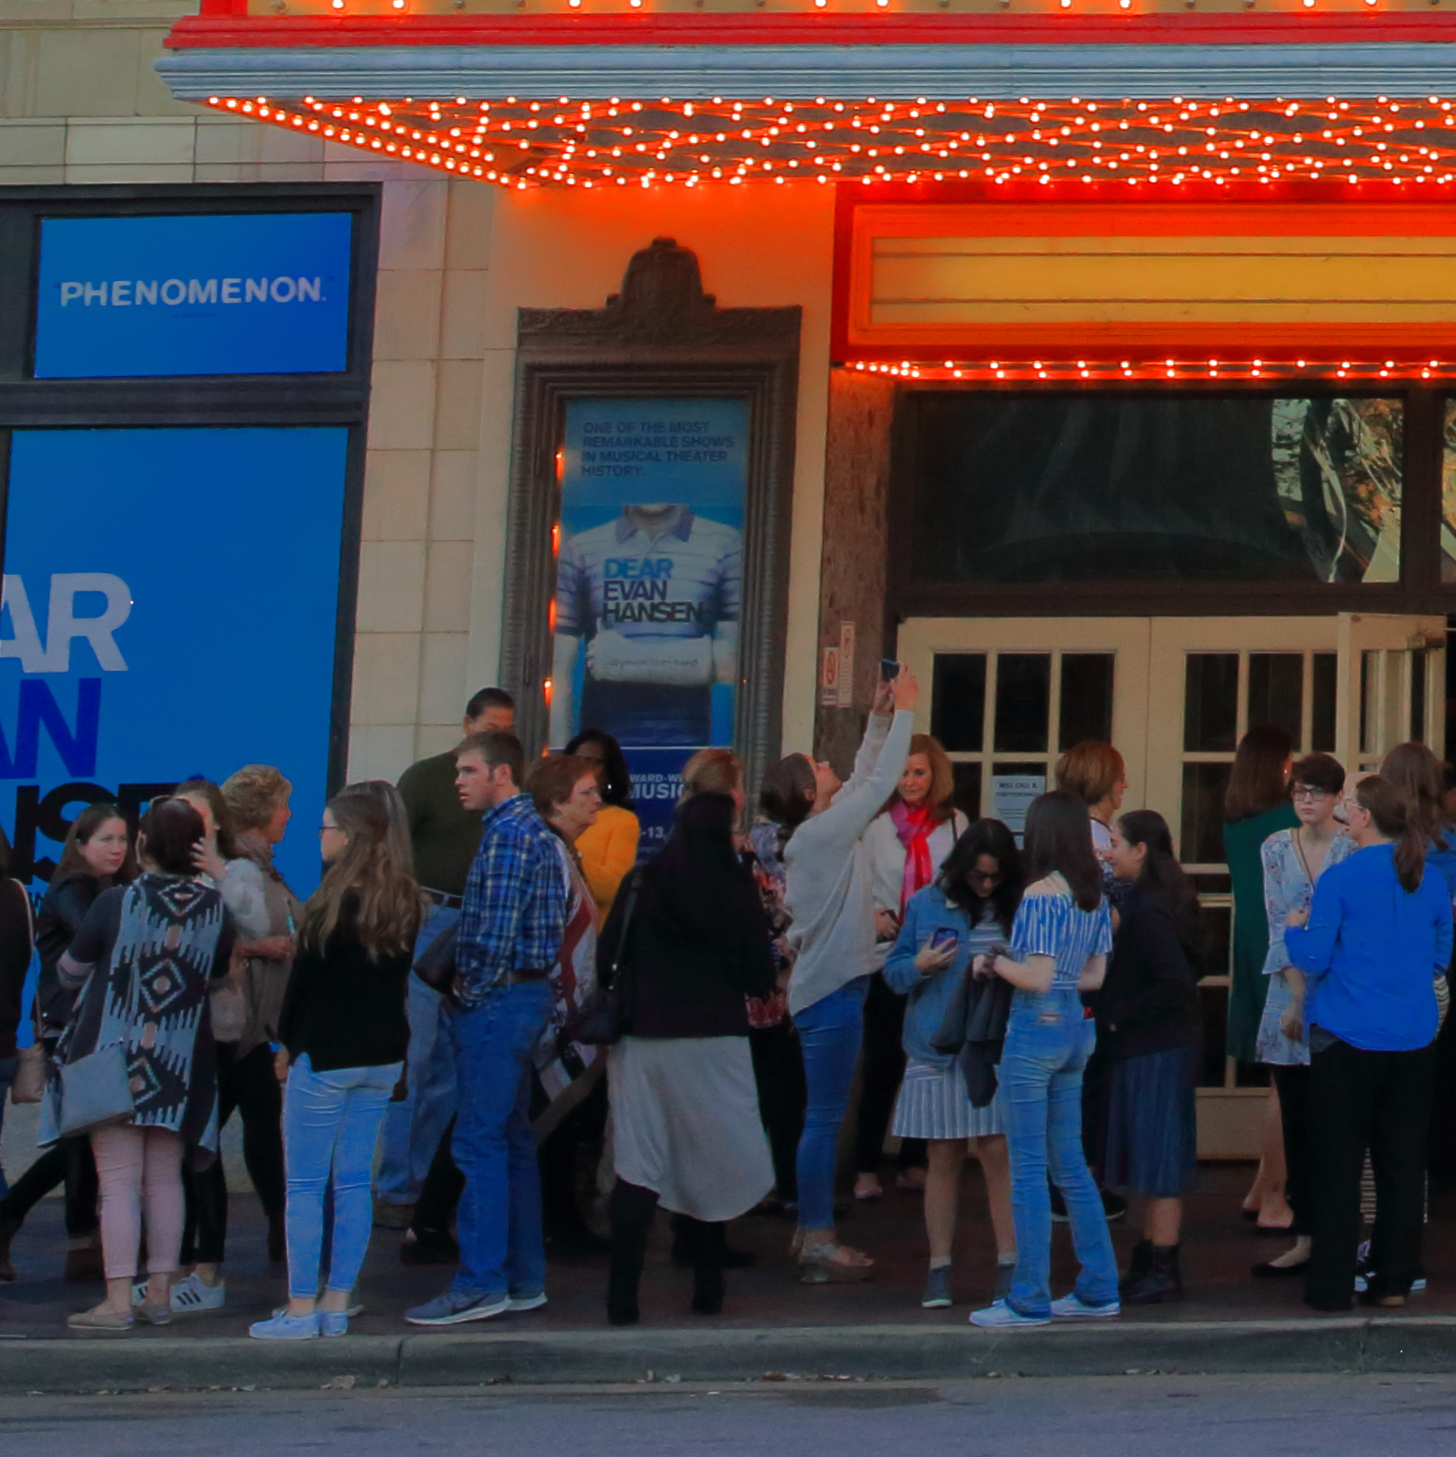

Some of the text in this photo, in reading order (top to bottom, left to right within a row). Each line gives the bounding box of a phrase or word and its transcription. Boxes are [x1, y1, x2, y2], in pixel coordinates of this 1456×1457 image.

[583, 423, 613, 434] ONE
[616, 422, 636, 434] OF
[639, 423, 664, 433] THE
[583, 437, 735, 448] REMARKABLE SHOWS
[599, 451, 662, 463] MUSICAL
[667, 451, 728, 462] THEATER
[605, 559, 673, 579] DEAR
[603, 580, 668, 601] EVAN
[603, 602, 702, 622] HANSEN
